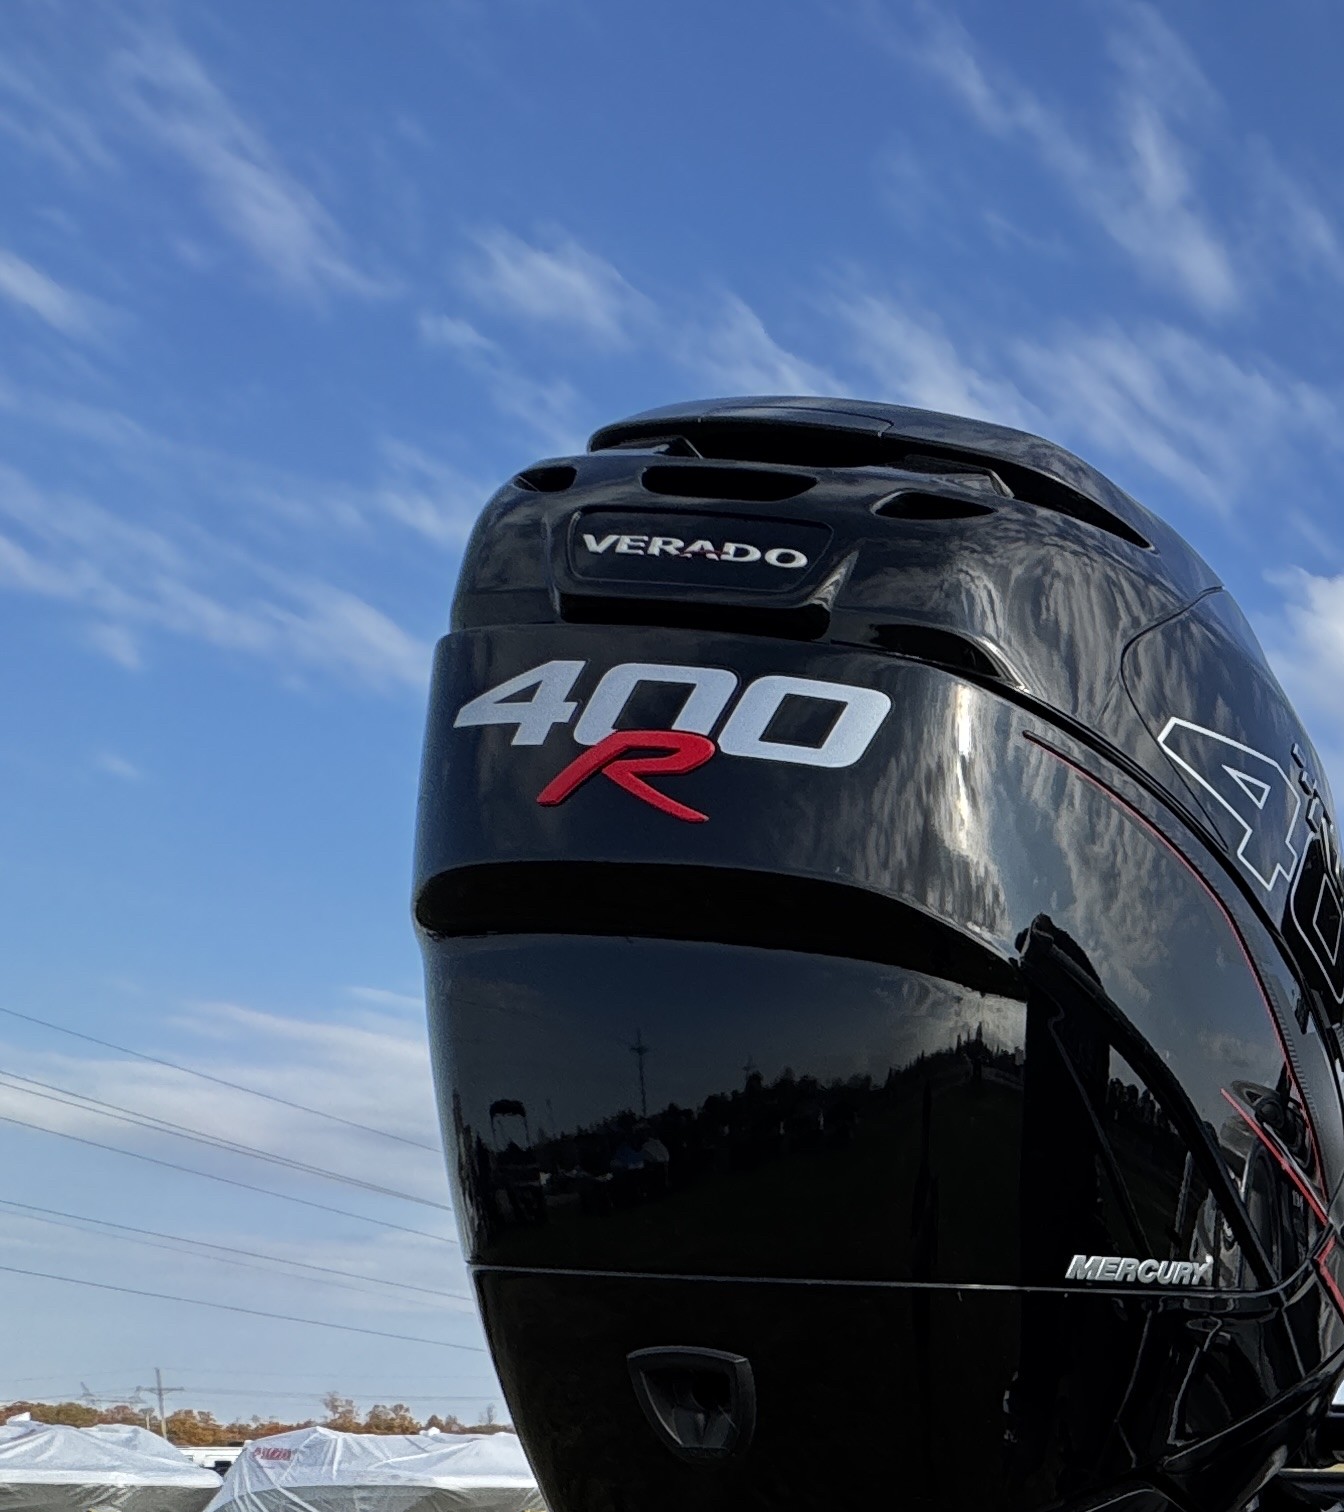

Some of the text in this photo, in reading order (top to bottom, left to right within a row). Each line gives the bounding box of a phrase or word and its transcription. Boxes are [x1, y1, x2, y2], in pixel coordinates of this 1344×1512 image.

[583, 533, 808, 569] VERADO
[453, 659, 892, 769] 400
[536, 729, 716, 823] R
[1065, 1254, 1214, 1286] MERCURY
